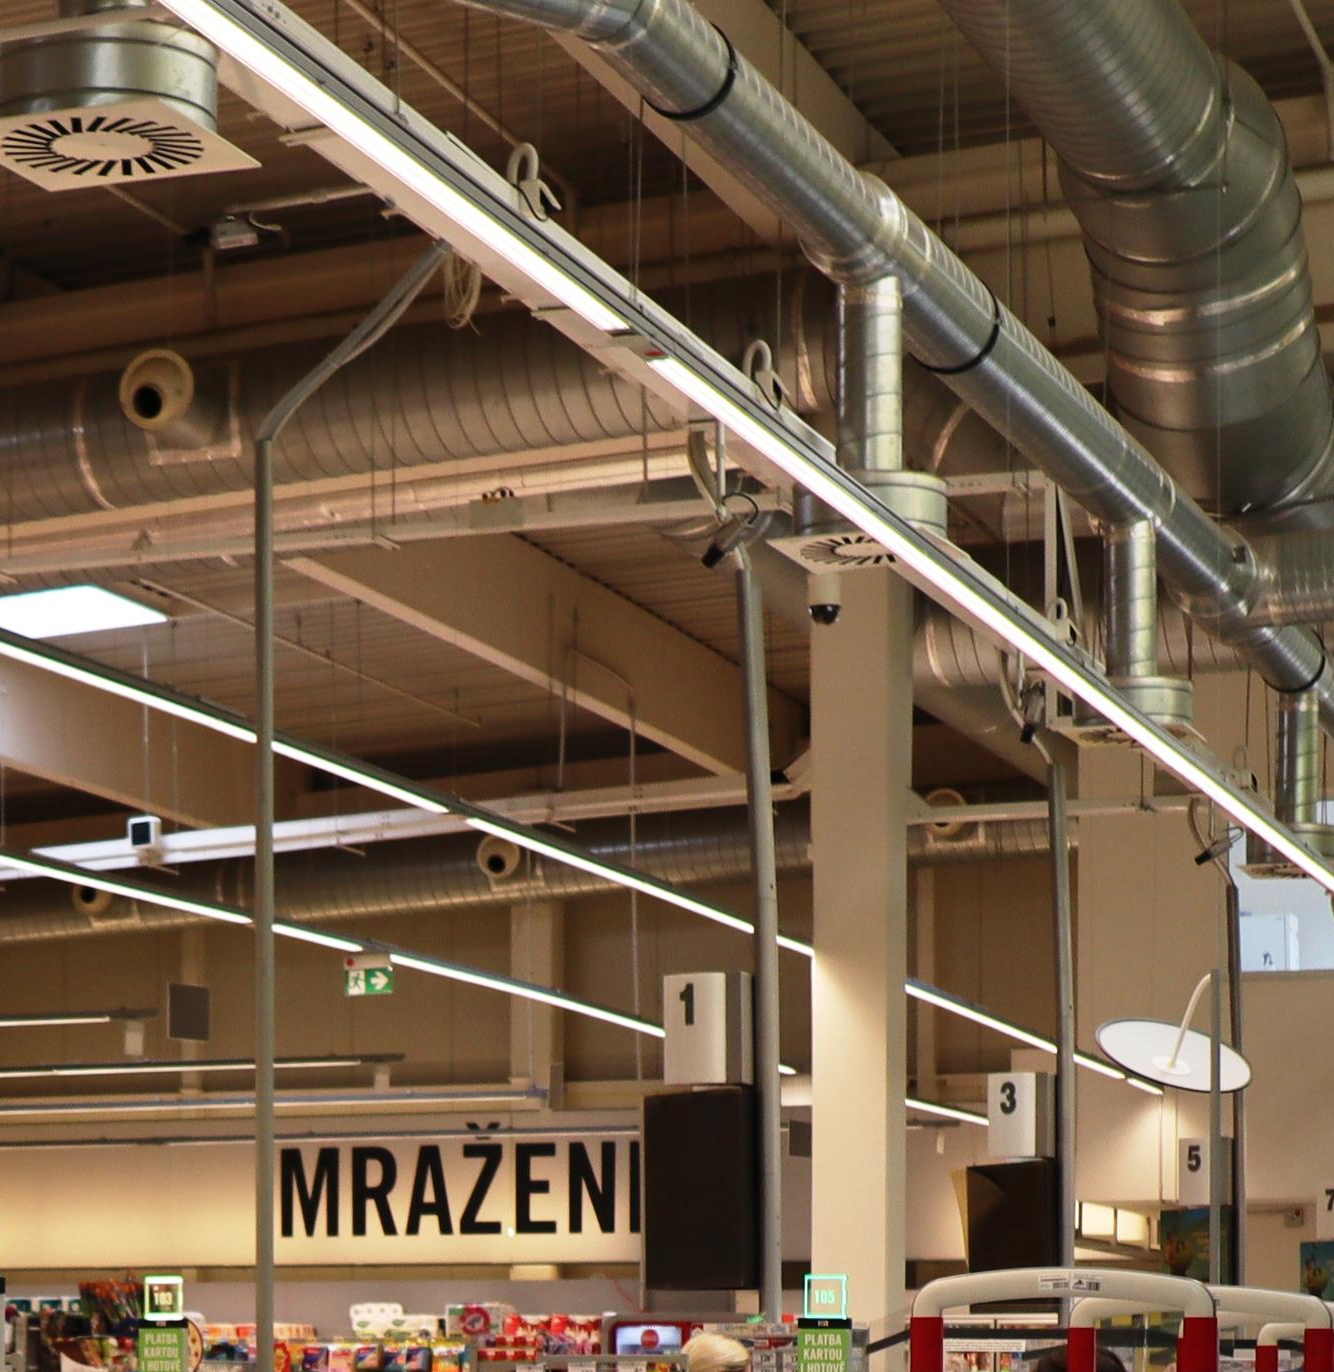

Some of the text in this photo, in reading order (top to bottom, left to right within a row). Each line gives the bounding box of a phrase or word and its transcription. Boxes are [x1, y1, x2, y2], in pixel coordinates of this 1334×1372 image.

[679, 982, 695, 1026] 1
[1000, 1081, 1017, 1115] 3
[1187, 1145, 1202, 1173] 5
[280, 1121, 540, 1238] MRAŽEN
[153, 1291, 173, 1306] 103
[814, 1289, 836, 1304] 105
[145, 1333, 178, 1345] PLATBA
[804, 1334, 842, 1346] PLATBA
[143, 1347, 179, 1358] KARTOU
[803, 1348, 843, 1360] KARTOU
[148, 1360, 181, 1372] HOTOVĚ
